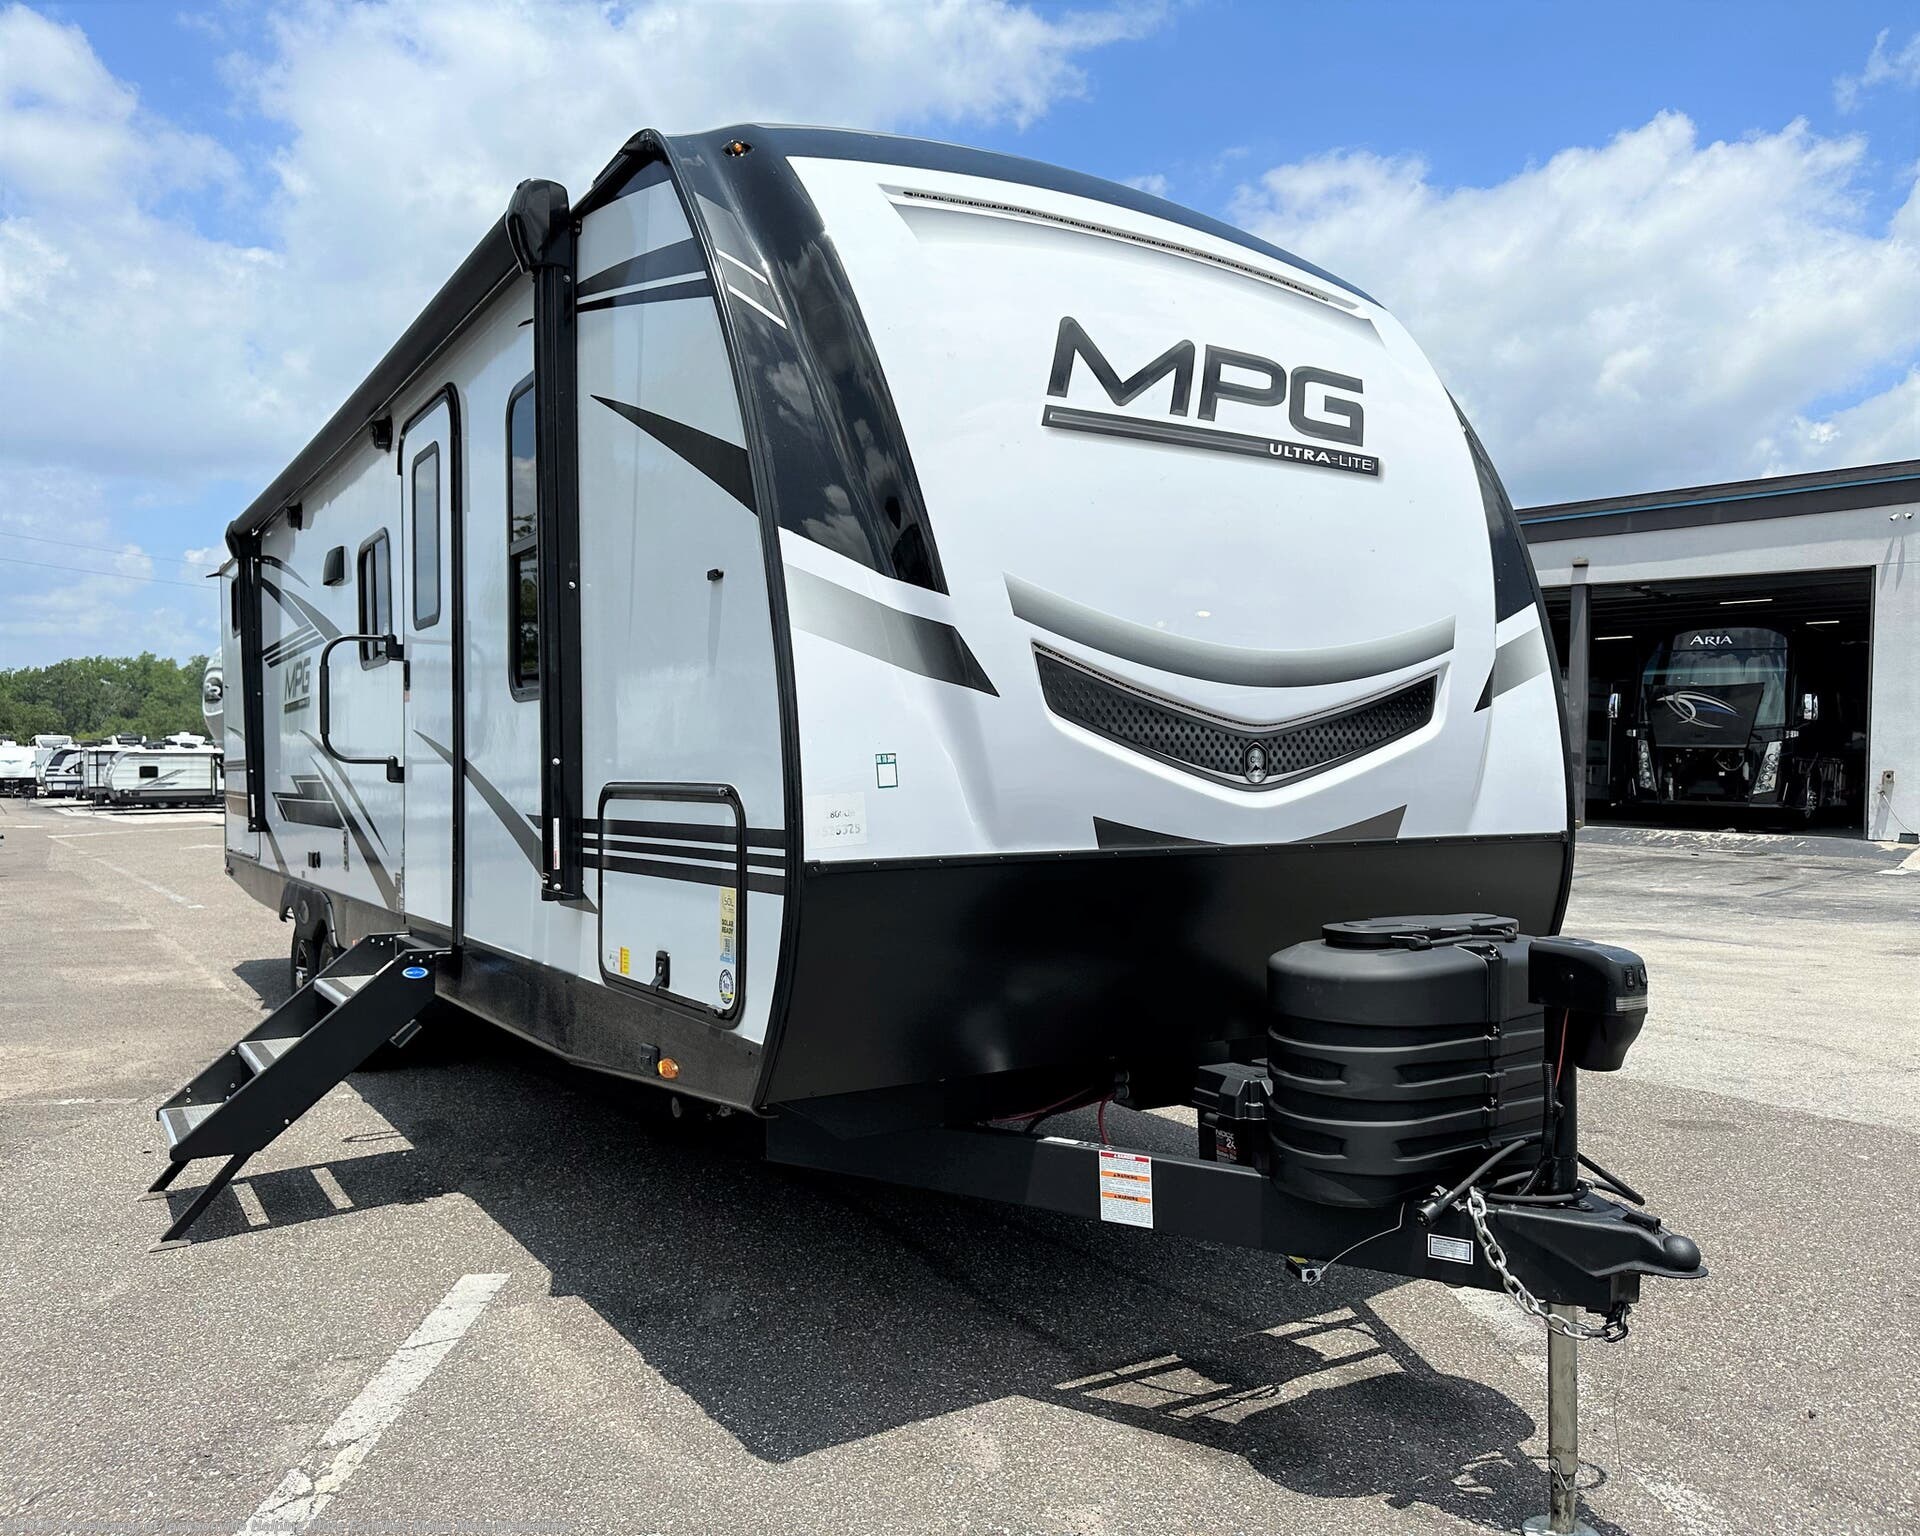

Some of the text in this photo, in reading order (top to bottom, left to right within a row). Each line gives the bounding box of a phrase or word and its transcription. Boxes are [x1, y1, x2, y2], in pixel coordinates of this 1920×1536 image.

[1046, 316, 1364, 447] MPG
[1269, 443, 1372, 471] ULTRA-LITE
[1689, 635, 1733, 647] ARIA
[284, 656, 311, 701] MPG
